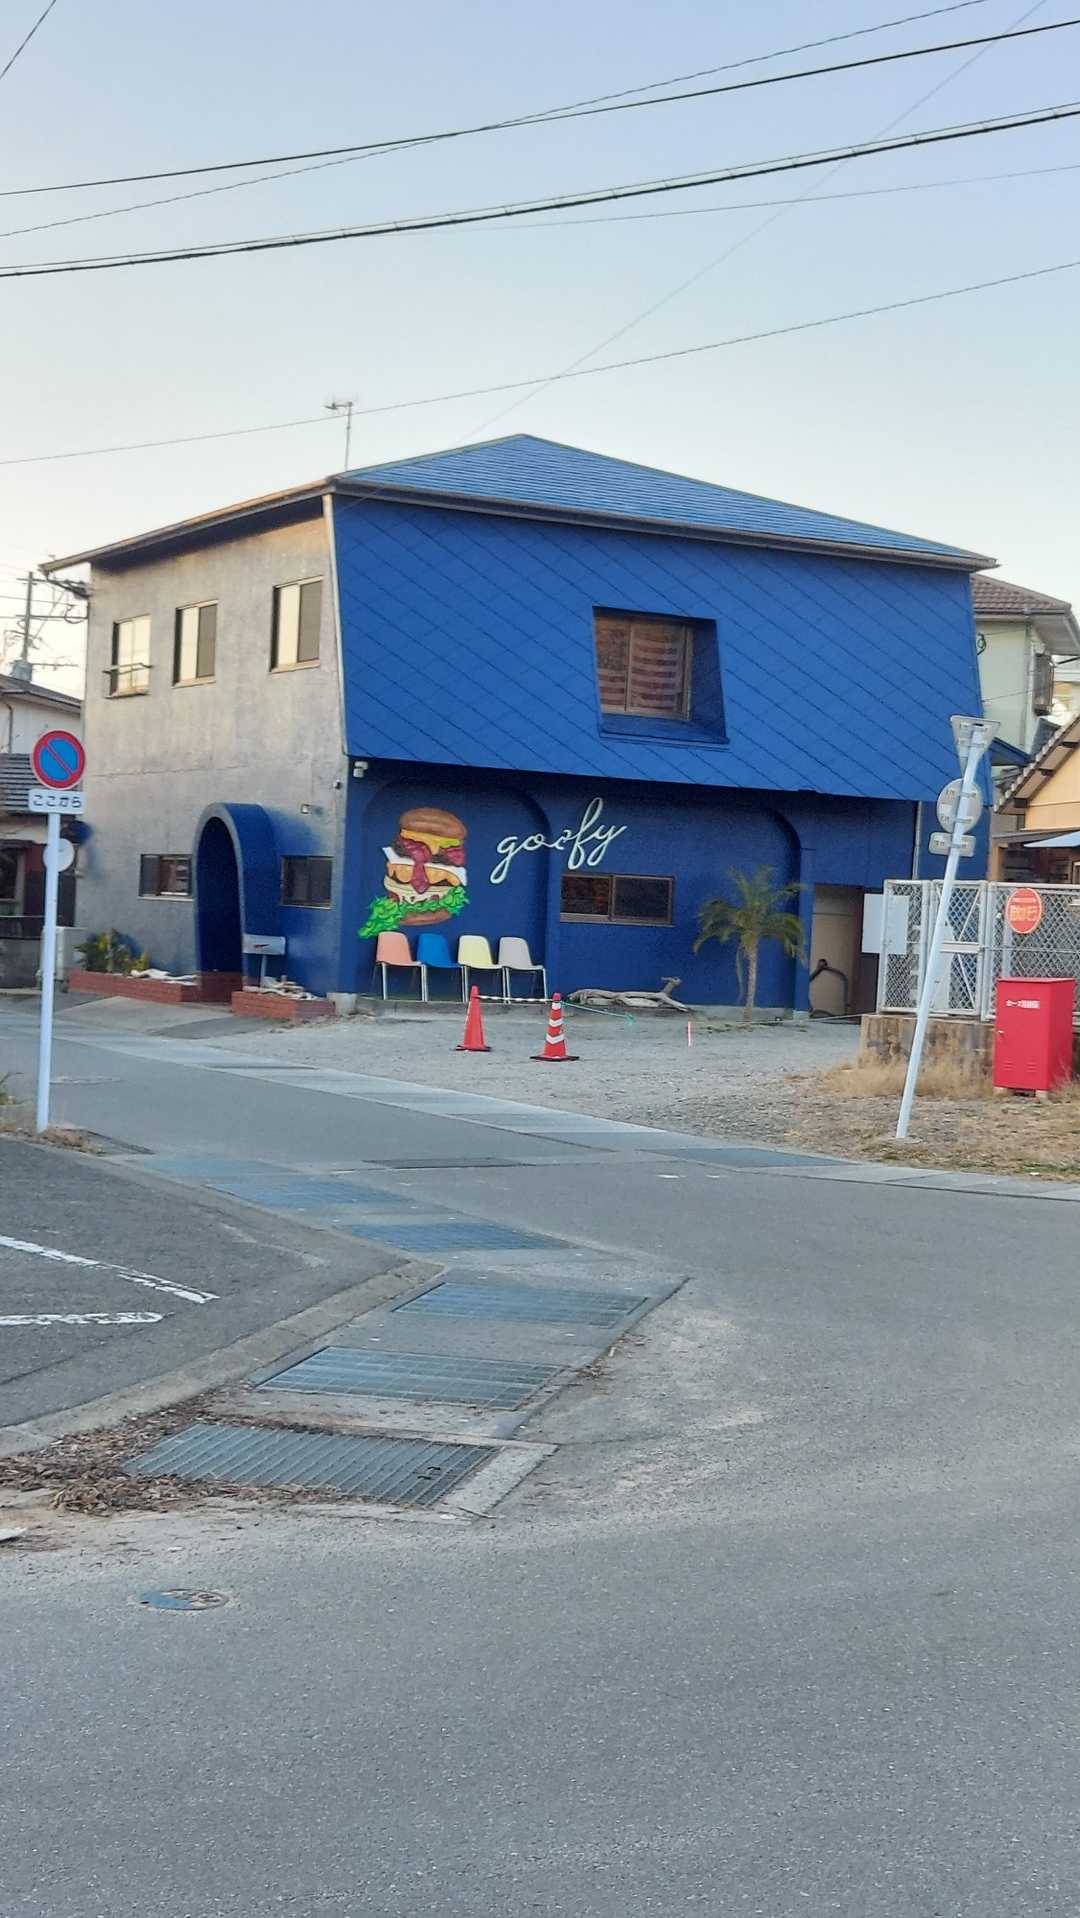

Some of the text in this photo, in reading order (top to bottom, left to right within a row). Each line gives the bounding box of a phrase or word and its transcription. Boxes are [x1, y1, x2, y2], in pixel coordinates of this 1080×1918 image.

[33, 794, 82, 808] ここから
[490, 797, 627, 884] goofy
